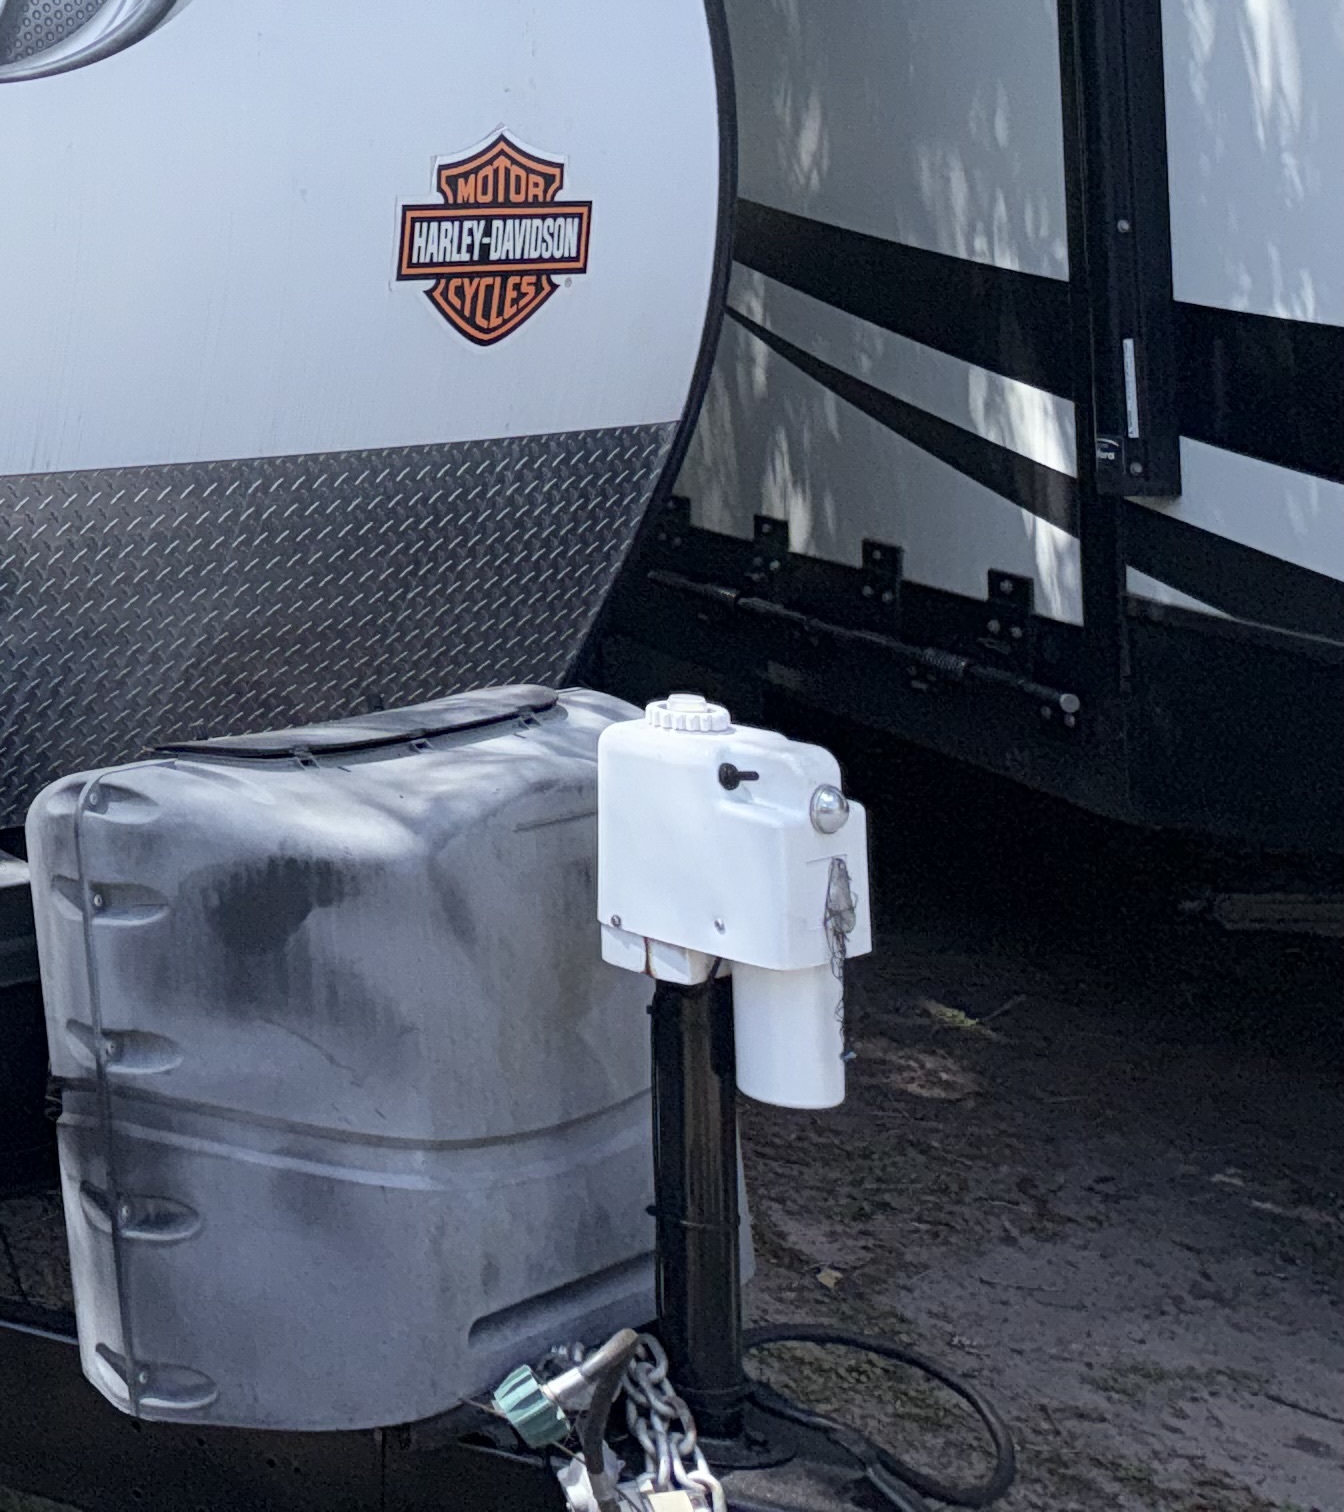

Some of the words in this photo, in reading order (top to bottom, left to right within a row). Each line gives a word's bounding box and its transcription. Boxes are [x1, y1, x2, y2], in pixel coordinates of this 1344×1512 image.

[457, 155, 545, 204] MOTOR
[412, 217, 579, 263] HARLEY-DAVIDSON
[447, 275, 537, 329] CYCLES
